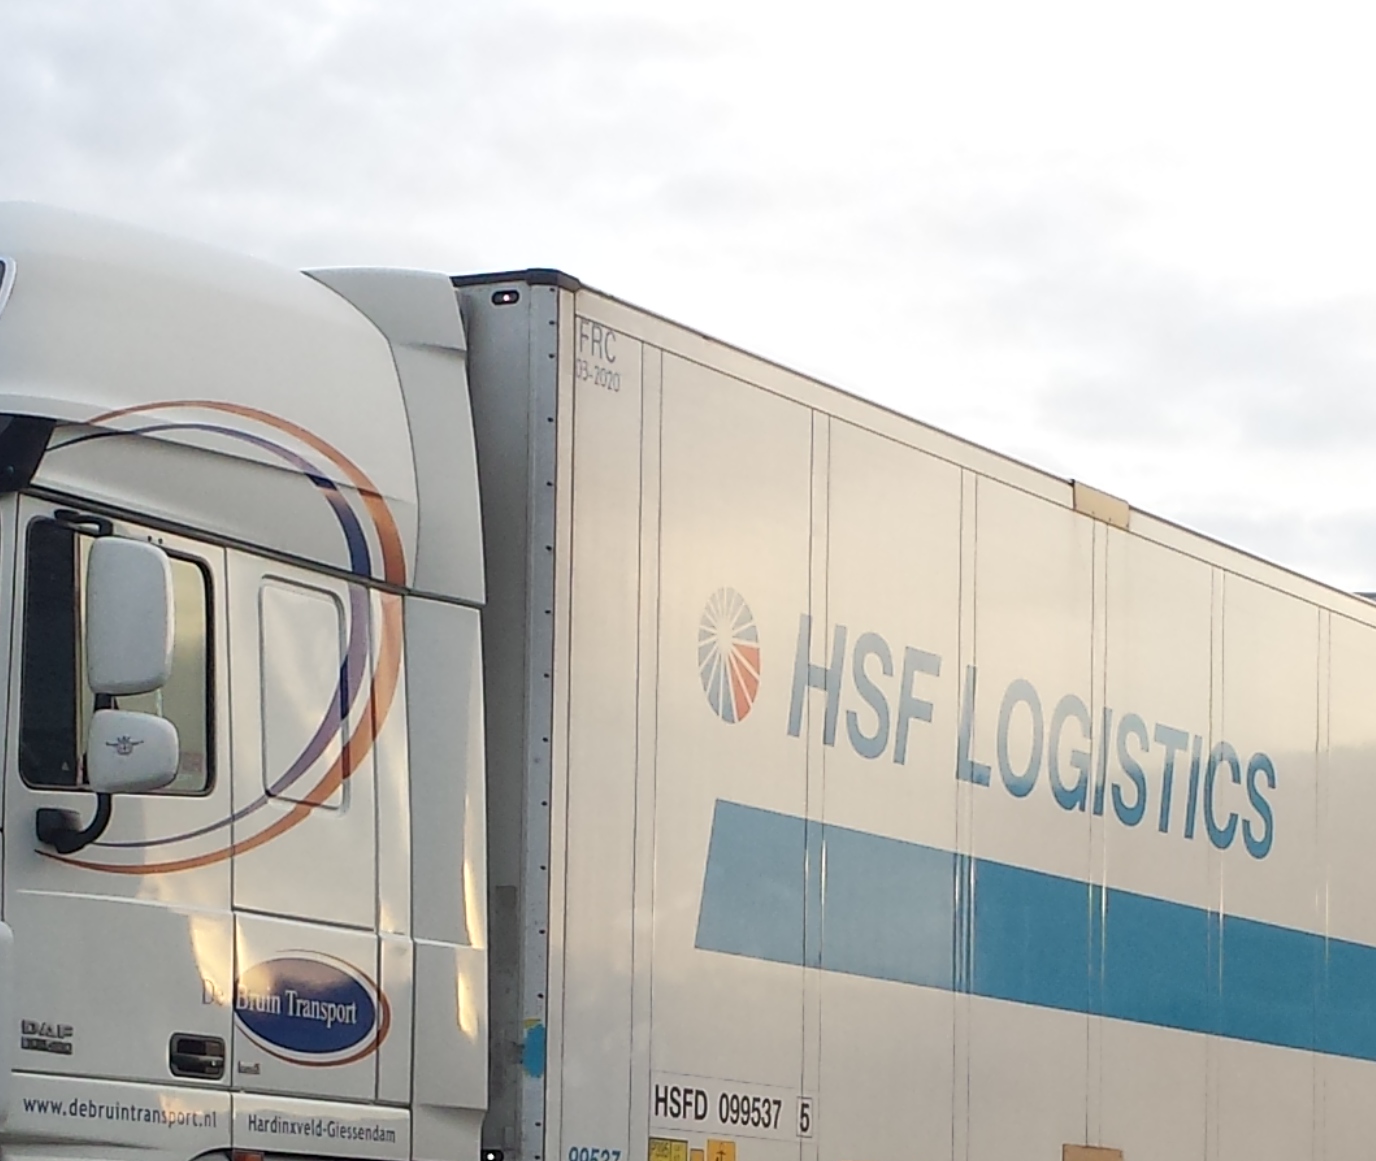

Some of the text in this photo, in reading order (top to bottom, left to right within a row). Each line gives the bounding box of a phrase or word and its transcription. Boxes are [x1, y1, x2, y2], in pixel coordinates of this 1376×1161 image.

[580, 319, 616, 364] FRC
[786, 613, 1277, 859] HSF LOGISTICS
[235, 984, 281, 1015] Bruin
[284, 989, 358, 1029] Transport
[22, 1097, 217, 1129] www.debruintransport.nl
[248, 1113, 397, 1144] Hardinxveld-Giessendam
[654, 1084, 811, 1133] HSFD 099537 5
